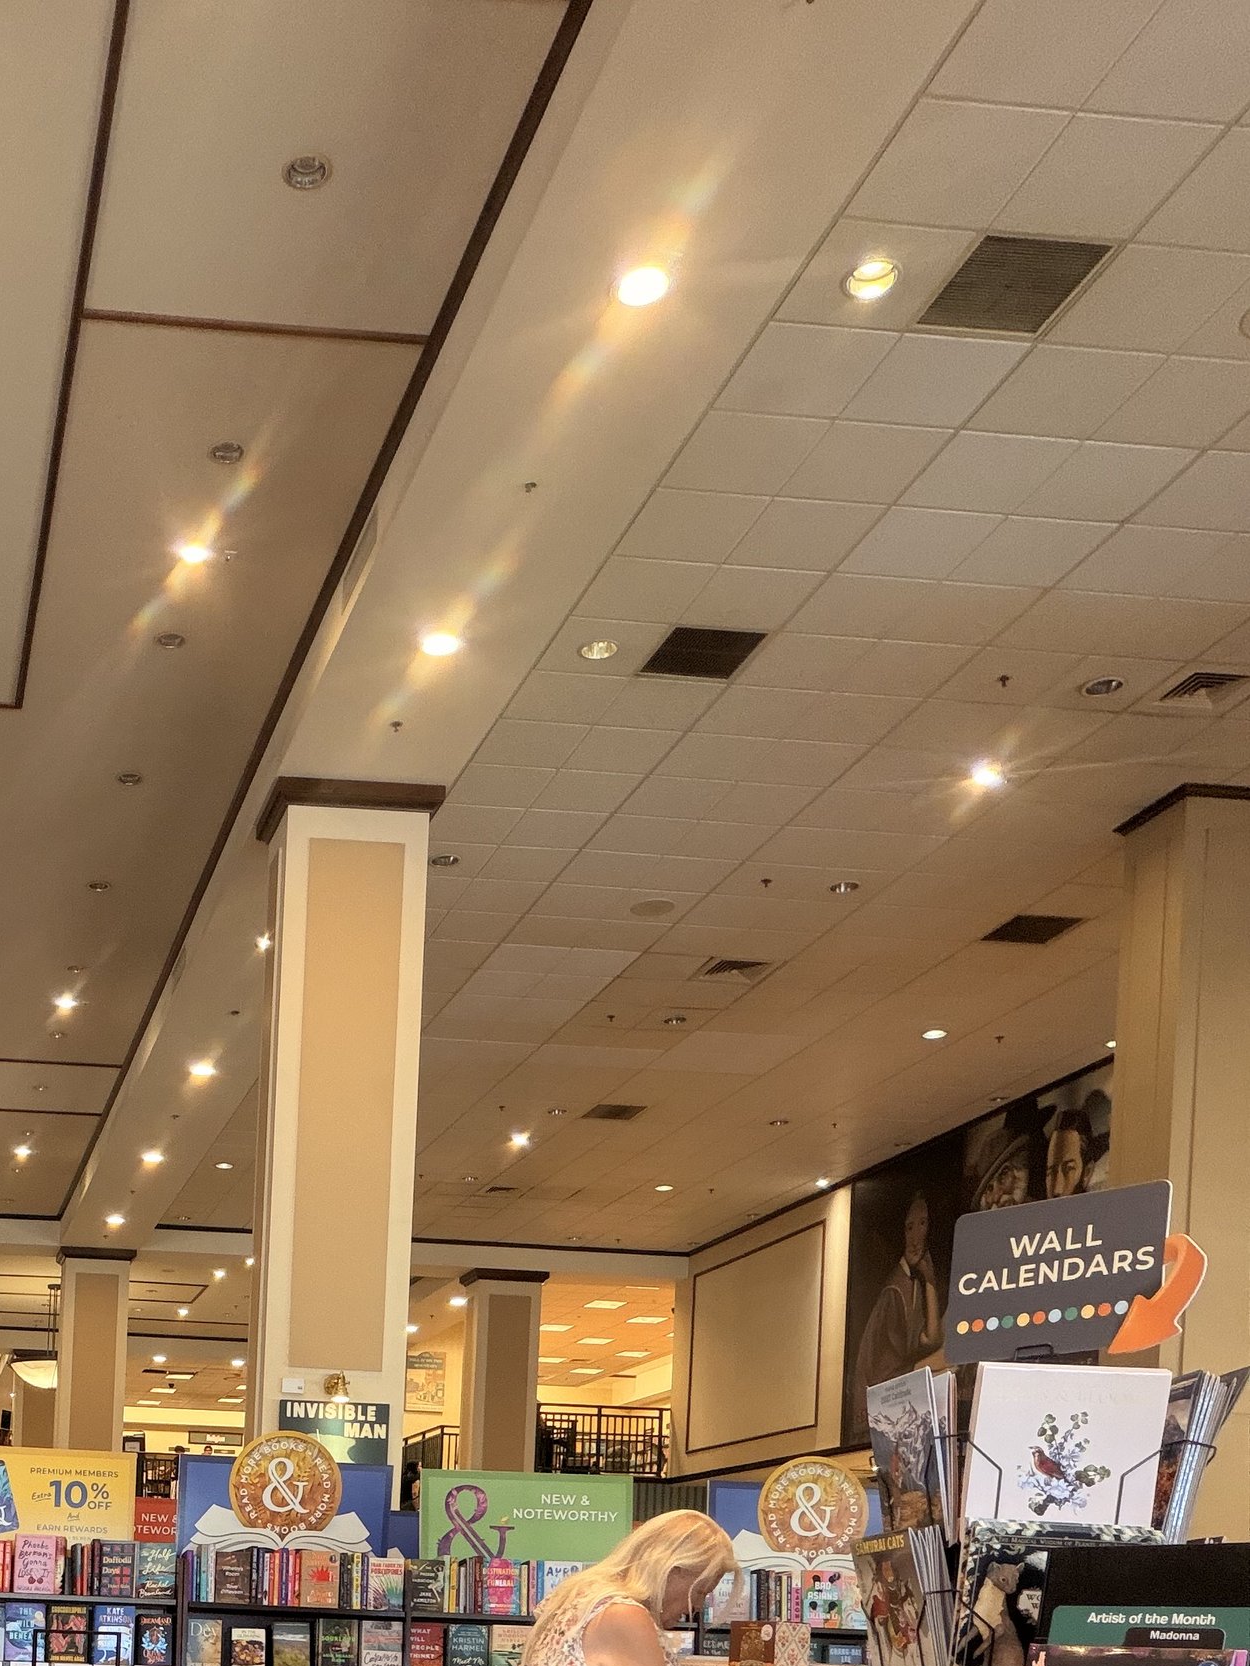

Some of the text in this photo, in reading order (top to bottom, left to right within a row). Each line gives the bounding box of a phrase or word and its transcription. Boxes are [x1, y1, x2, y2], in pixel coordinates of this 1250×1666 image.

[1009, 1224, 1103, 1259] WALL
[957, 1245, 1156, 1296] CALENDARS
[286, 1401, 377, 1422] INVISIBLE
[343, 1422, 387, 1440] MAN
[30, 1466, 119, 1479] PREMIUM MEMBERS
[313, 1458, 332, 1490] READ
[239, 1440, 305, 1521] READ MORE BOOKS
[31, 1491, 52, 1501] Extra
[49, 1480, 110, 1509] 10%
[541, 1493, 591, 1506] NEW &
[87, 1501, 113, 1511] OFF
[308, 1493, 330, 1525] MORE
[768, 1465, 831, 1545] READ MORE BOOKS
[141, 1512, 169, 1523] NEW
[513, 1507, 619, 1523] NOTEWORTHY
[793, 1481, 858, 1559] READ MORE BOOKS
[36, 1523, 109, 1535] EARN REWARDS
[266, 1521, 307, 1535] BOOKS
[855, 1535, 905, 1553] SAMURAI CATS
[102, 1556, 132, 1564] Daffodil
[814, 1581, 832, 1590] BAD
[807, 1591, 839, 1601] ASIANS
[18, 1606, 33, 1615] THE
[106, 1606, 125, 1616] KATE
[99, 1614, 133, 1624] ATKINSON
[1087, 1612, 1217, 1626] Artist of the Month
[410, 1627, 431, 1635] WHAT
[1150, 1630, 1200, 1641] Madonna
[452, 1637, 485, 1645] KRISTIN
[451, 1644, 485, 1652] HARMEL
